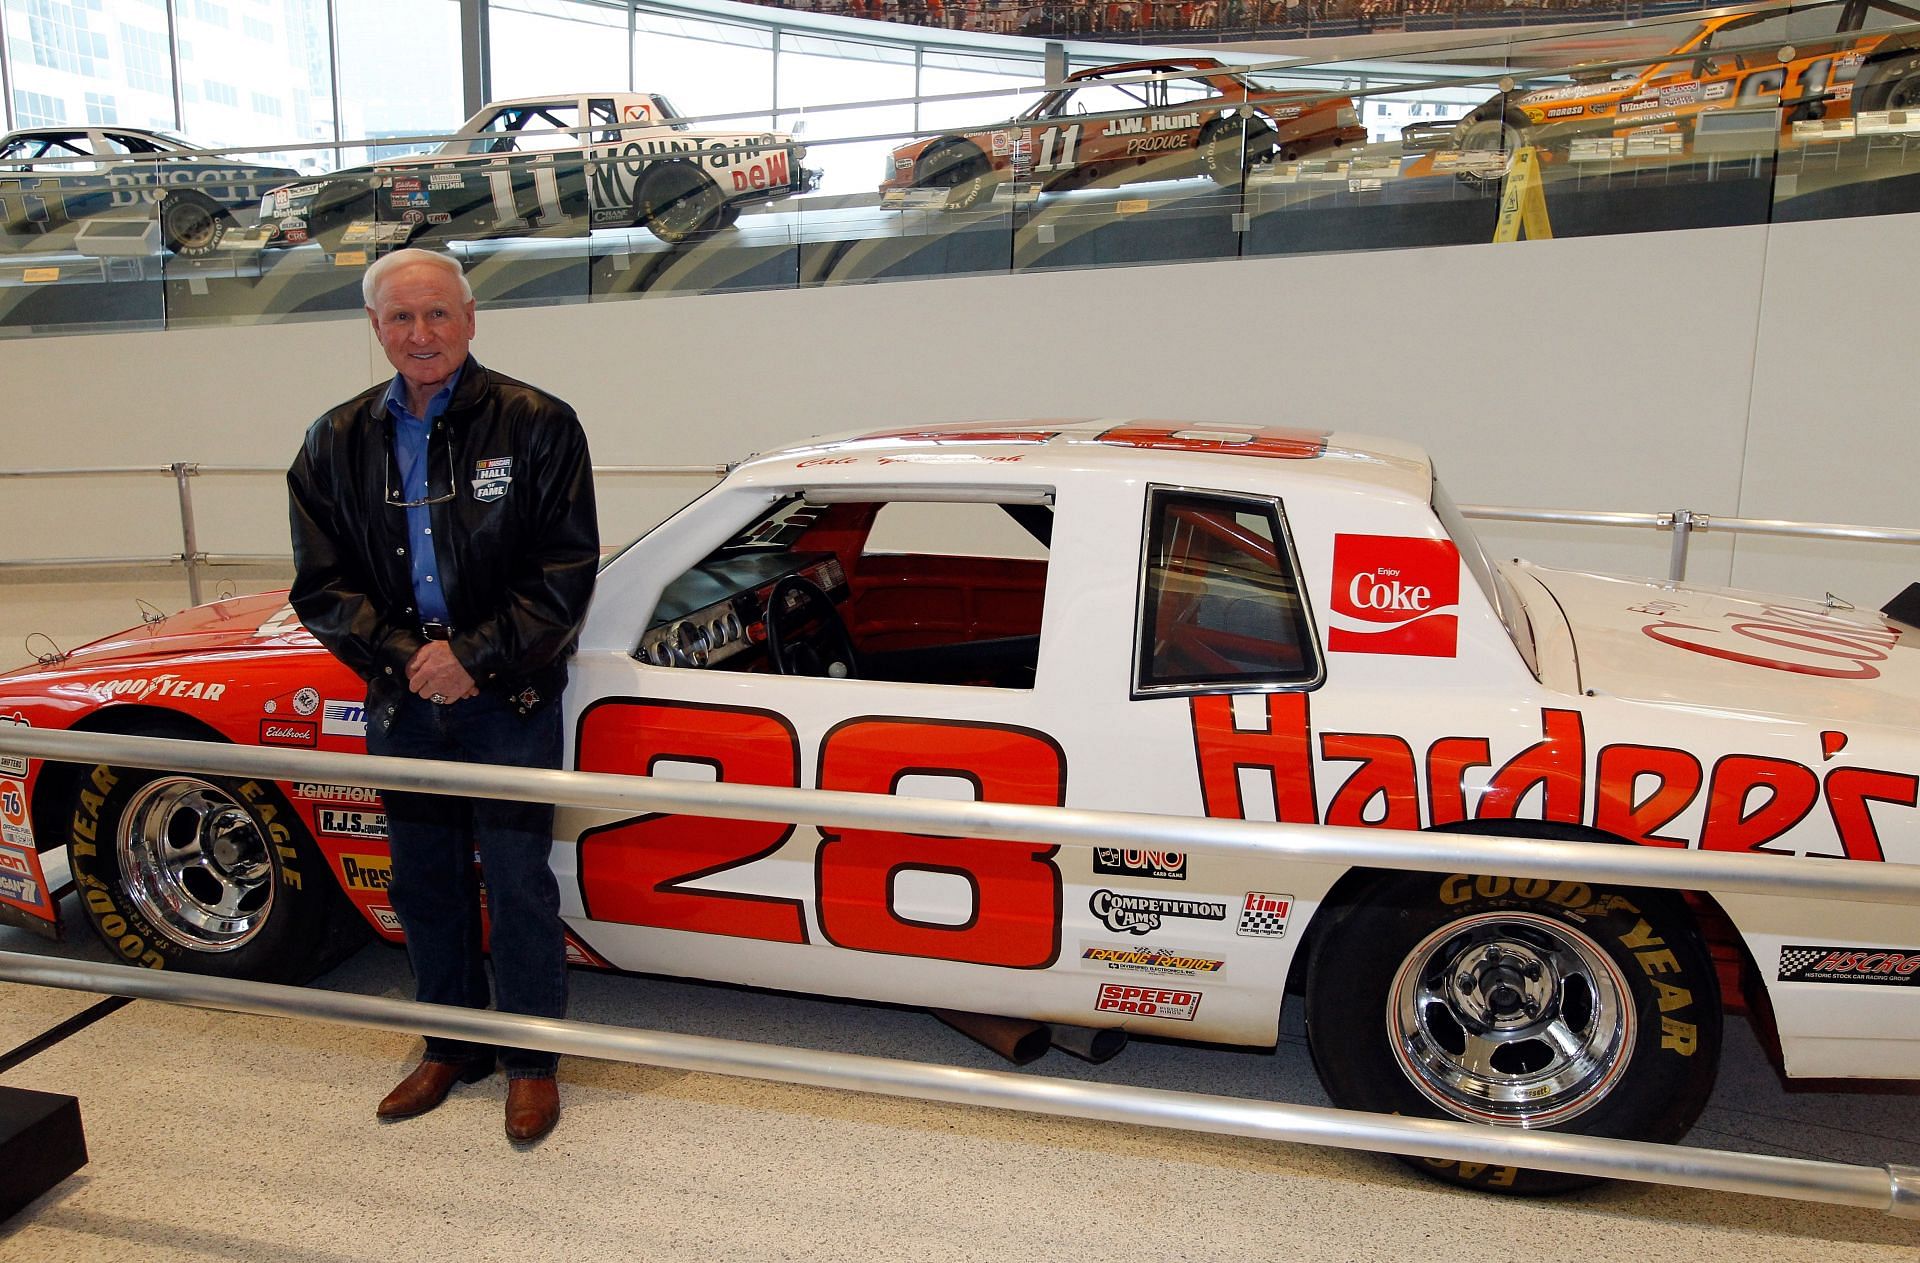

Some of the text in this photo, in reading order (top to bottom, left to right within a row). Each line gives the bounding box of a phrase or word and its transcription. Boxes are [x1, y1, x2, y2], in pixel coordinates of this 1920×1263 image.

[1621, 100, 1658, 112] Winston
[1103, 112, 1200, 136] J.W. Hunt
[1034, 124, 1080, 173] 11
[1127, 134, 1188, 155] PRODUCE
[105, 170, 262, 208] BUSCH
[480, 154, 575, 231] 11
[429, 213, 450, 222] TRW
[481, 469, 506, 479] HALL
[477, 486, 504, 498] FAME
[1378, 567, 1400, 577] Enjoy
[1349, 572, 1431, 611] Coke
[265, 726, 311, 740] Edelbrock
[1, 757, 23, 769] SHIFTERS
[1189, 691, 1919, 863] Hardee's
[3, 793, 20, 814] 76
[298, 783, 377, 803] IGNITION
[322, 811, 365, 834] R.J.S.
[574, 696, 1068, 970] 28
[237, 781, 302, 891] EAGLE
[1124, 849, 1183, 872] UNO
[1093, 891, 1224, 918] COMPETITION
[1245, 893, 1289, 918] king
[1107, 907, 1159, 932] CAMS
[1090, 949, 1216, 971] RACING RADIOS
[1813, 951, 1920, 975] HSCRG
[1100, 998, 1157, 1015] PRO
[1103, 986, 1192, 1006] SPEED
